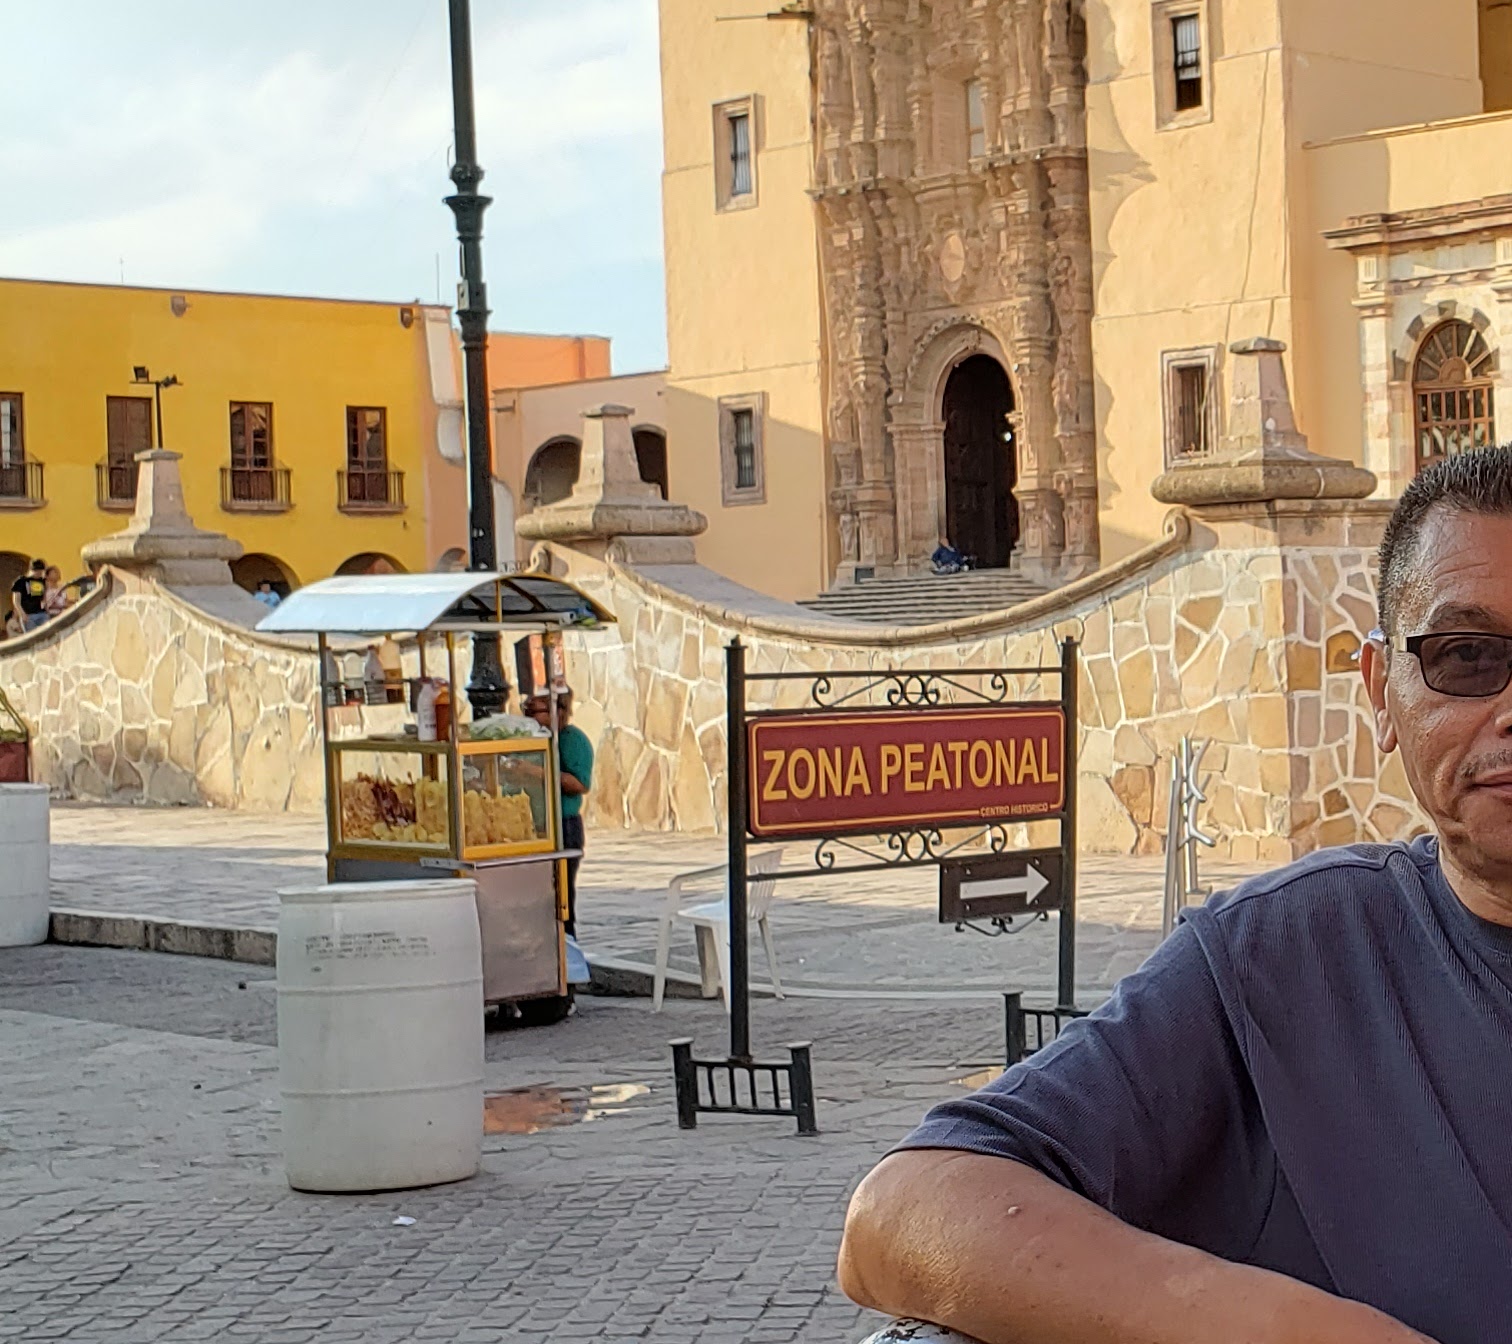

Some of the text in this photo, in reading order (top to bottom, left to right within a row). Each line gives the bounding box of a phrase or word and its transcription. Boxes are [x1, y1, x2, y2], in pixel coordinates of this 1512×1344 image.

[762, 737, 1058, 801] ZONA PEATONAL
[980, 805, 1010, 817] CENTRO
